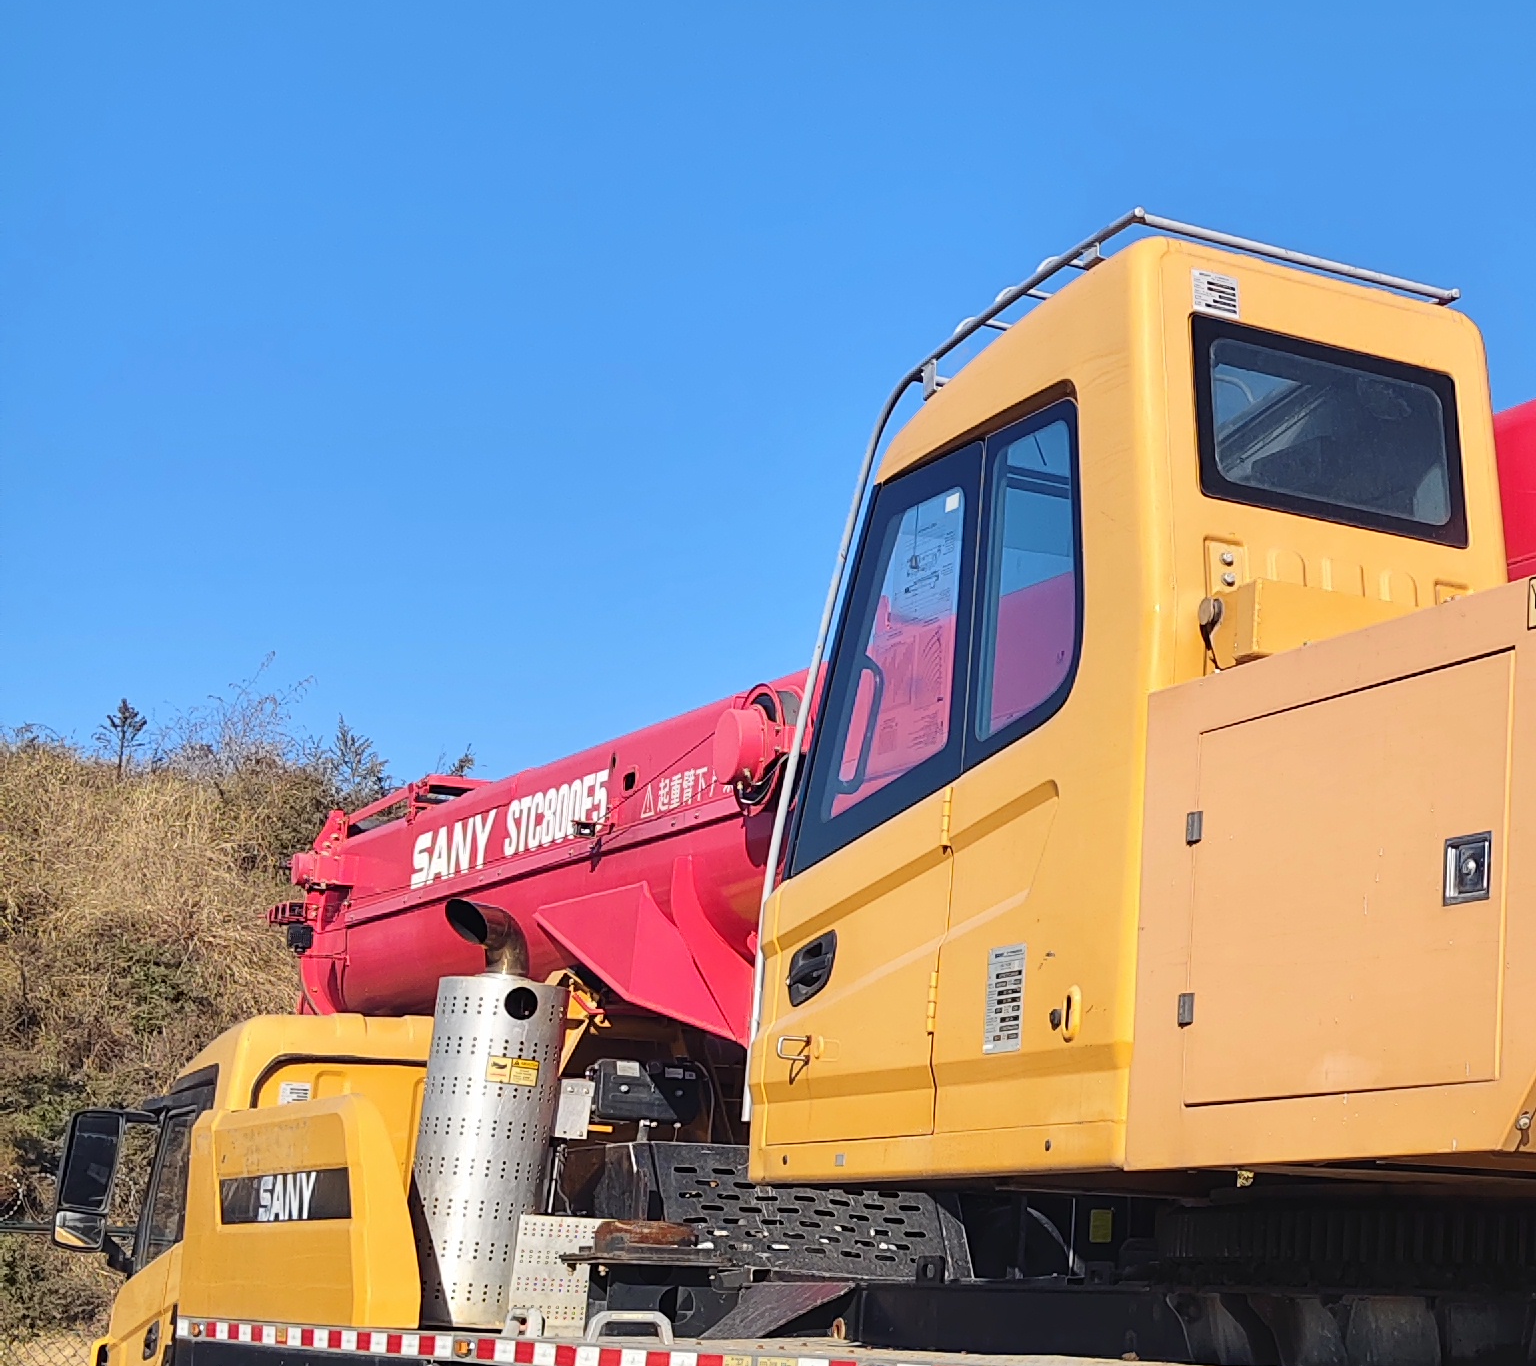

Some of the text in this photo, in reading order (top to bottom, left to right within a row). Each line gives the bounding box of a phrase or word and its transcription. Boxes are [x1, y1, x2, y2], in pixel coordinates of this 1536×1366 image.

[411, 768, 610, 889] SANY STC800E5
[257, 1171, 317, 1222] SANY
